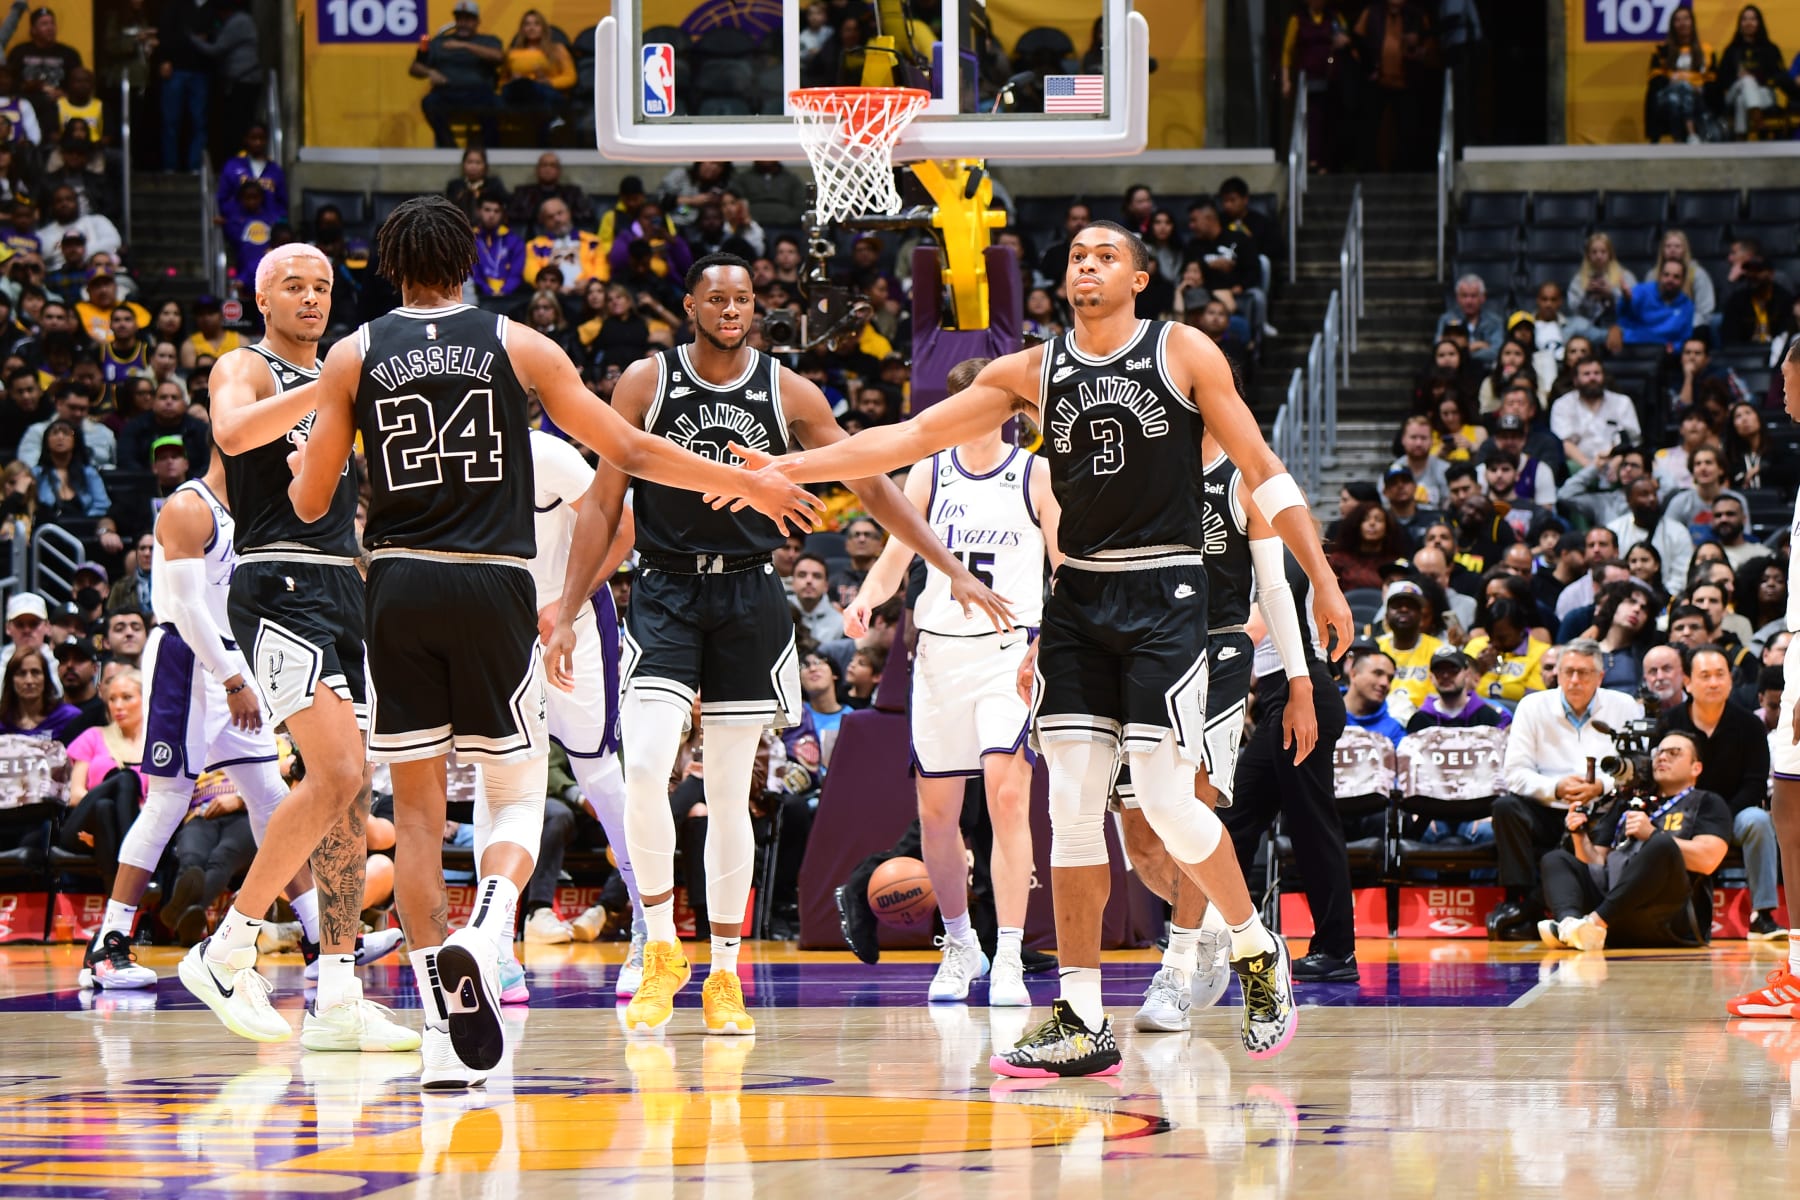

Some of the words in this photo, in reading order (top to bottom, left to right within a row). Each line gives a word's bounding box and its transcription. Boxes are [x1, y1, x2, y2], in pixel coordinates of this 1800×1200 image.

[327, 0, 418, 36] 106
[1597, 0, 1680, 34] 107
[646, 99, 663, 112] NBA
[1056, 352, 1066, 365] 6
[1125, 357, 1152, 370] Self.
[370, 346, 494, 391] VASSELL
[672, 371, 682, 382] 6
[745, 389, 768, 402] Self.
[1051, 397, 1080, 453] SAN
[1078, 376, 1169, 438] ANTONIO
[665, 413, 699, 449] AN
[698, 403, 770, 451] ANTONI
[375, 389, 502, 491] 24
[1090, 417, 1125, 475] 3
[1204, 482, 1225, 495] Self.
[1333, 749, 1380, 764] ELTA
[1431, 750, 1499, 766] DELTA
[0, 759, 49, 774] ELTA
[1663, 812, 1684, 831] 12
[876, 886, 924, 909] Wilson
[1428, 889, 1475, 907] BIO
[1428, 907, 1473, 916] STEEL
